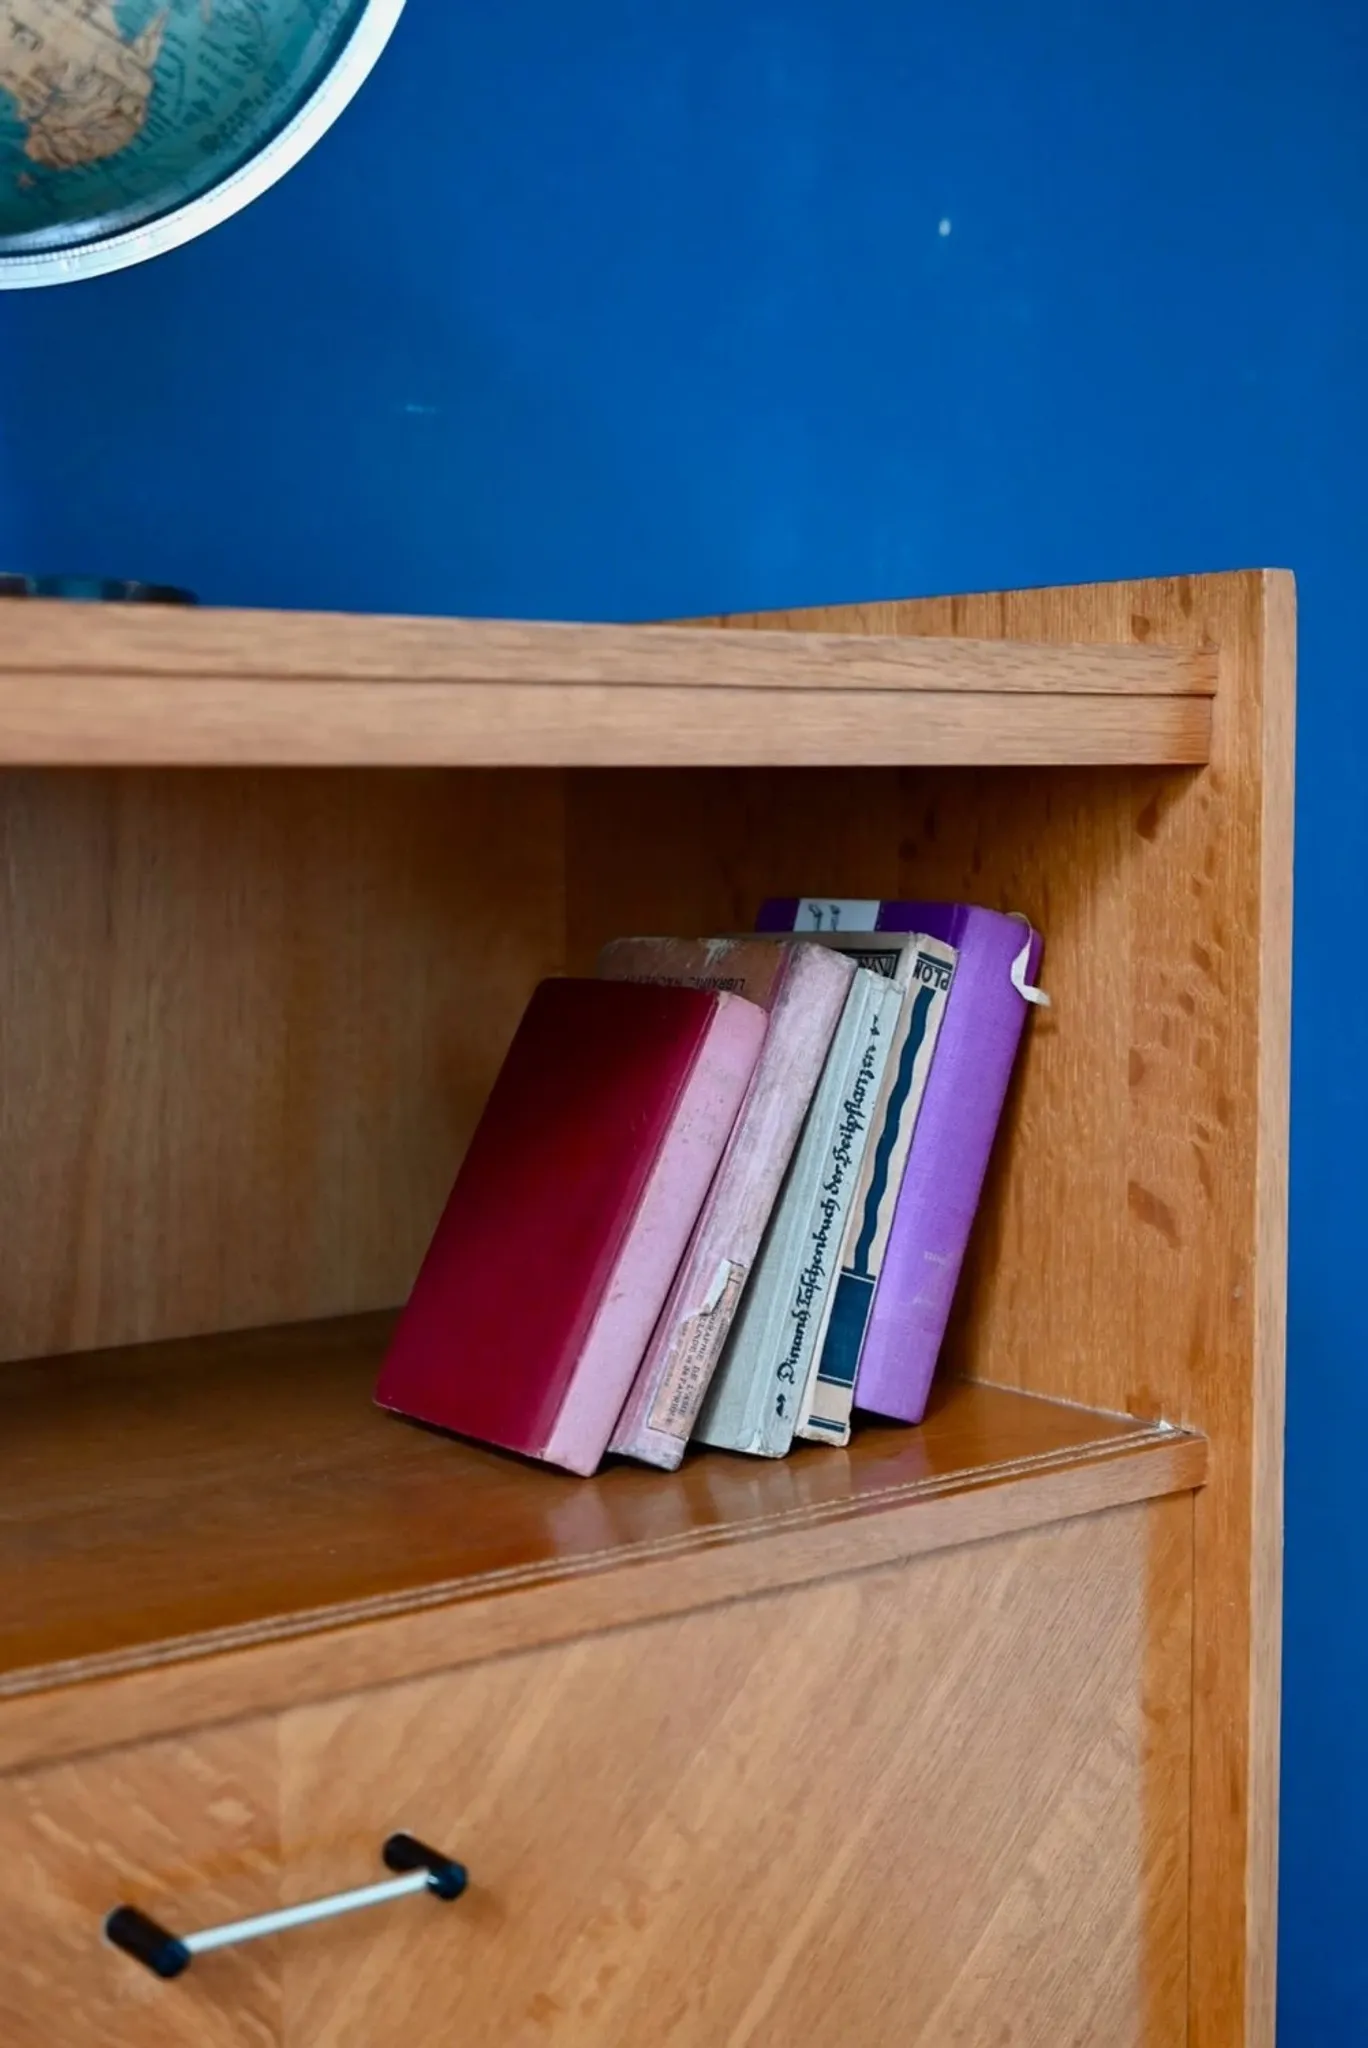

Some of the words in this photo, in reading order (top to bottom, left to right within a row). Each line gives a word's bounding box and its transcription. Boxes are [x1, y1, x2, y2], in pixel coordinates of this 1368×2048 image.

[912, 959, 952, 991] PLON
[833, 1044, 877, 1167] Heilpflanzen
[823, 1167, 845, 1195] der
